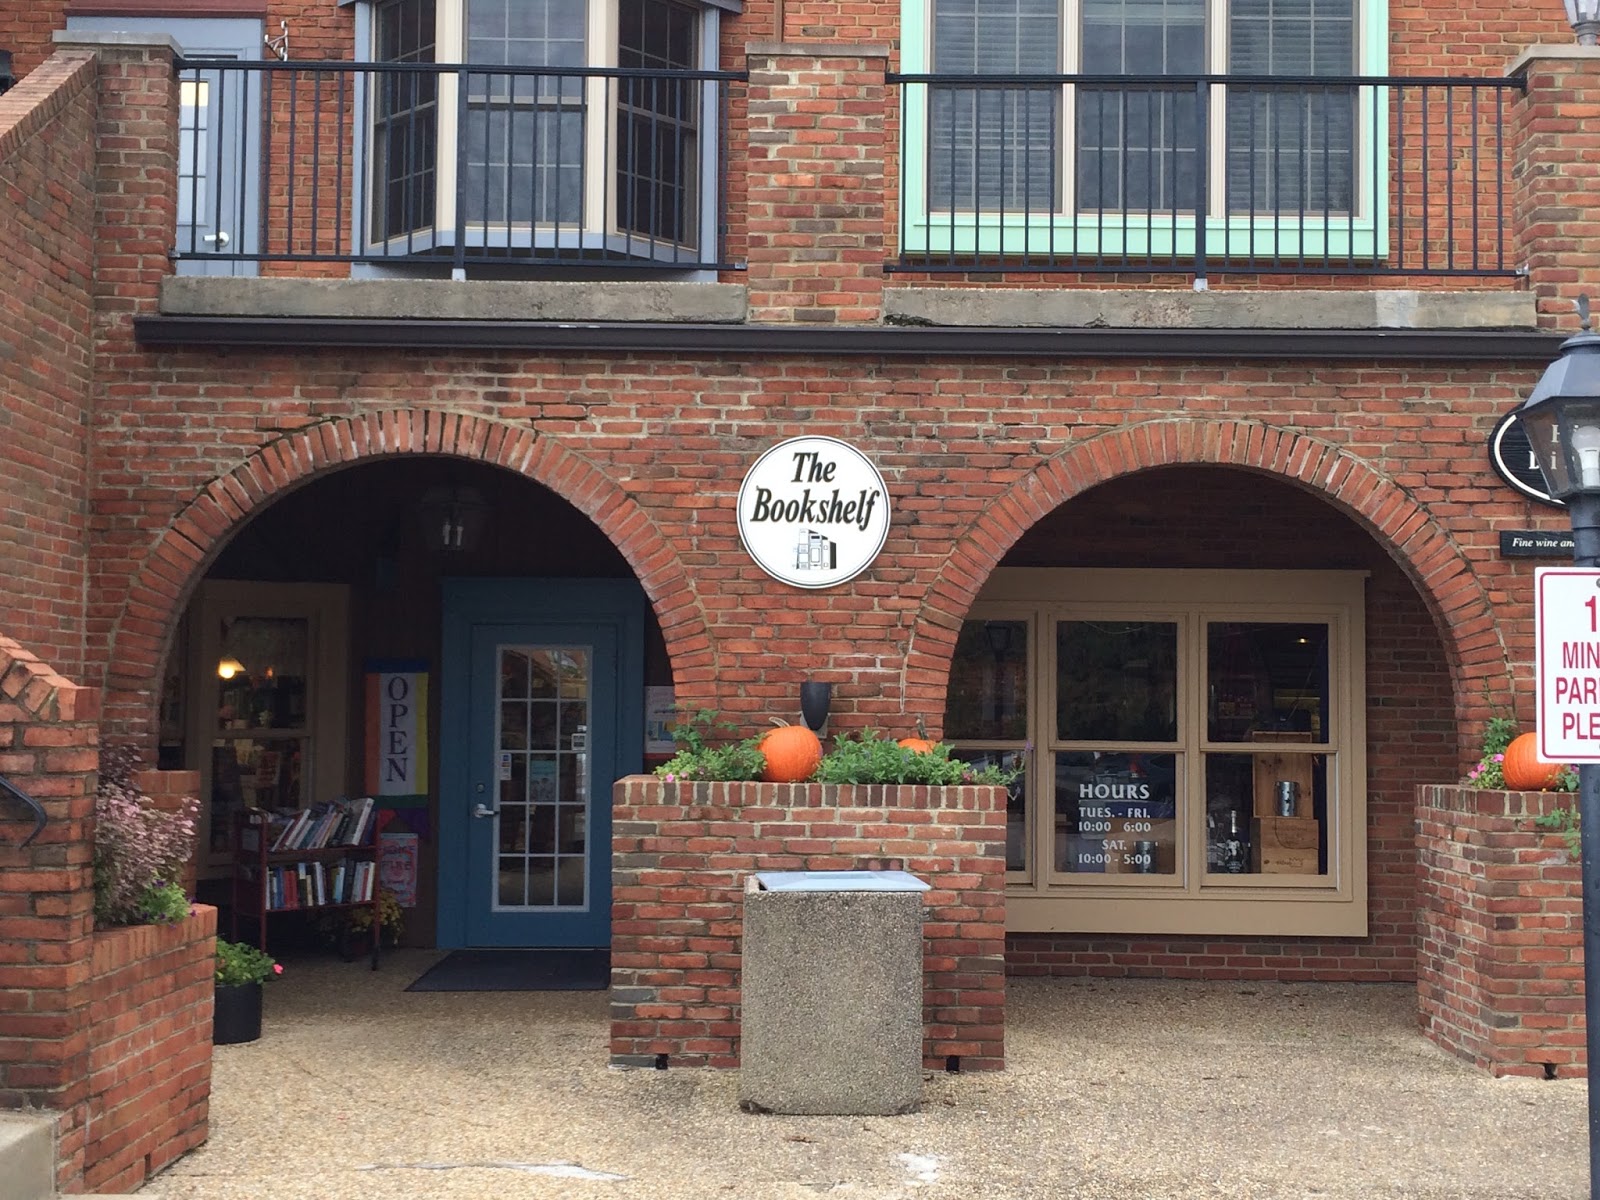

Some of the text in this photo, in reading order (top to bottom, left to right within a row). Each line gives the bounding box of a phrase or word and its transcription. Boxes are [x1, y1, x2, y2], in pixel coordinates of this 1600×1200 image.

[791, 451, 837, 483] The
[750, 488, 880, 532] Bookshelf
[1512, 537, 1534, 547] Fine
[1535, 538, 1558, 547] wine
[1562, 641, 1600, 669] MIN
[1556, 677, 1600, 705] PAR
[386, 676, 409, 783] OPEN
[1562, 712, 1600, 740] PLE
[1080, 783, 1150, 799] HOURS
[1079, 807, 1115, 818] TUES.
[1127, 808, 1151, 819] FRI.
[1078, 821, 1151, 832] 10:00 6:00
[1101, 839, 1127, 850] SAT.
[1078, 853, 1111, 864] 10:00
[1123, 854, 1151, 865] 5:00
